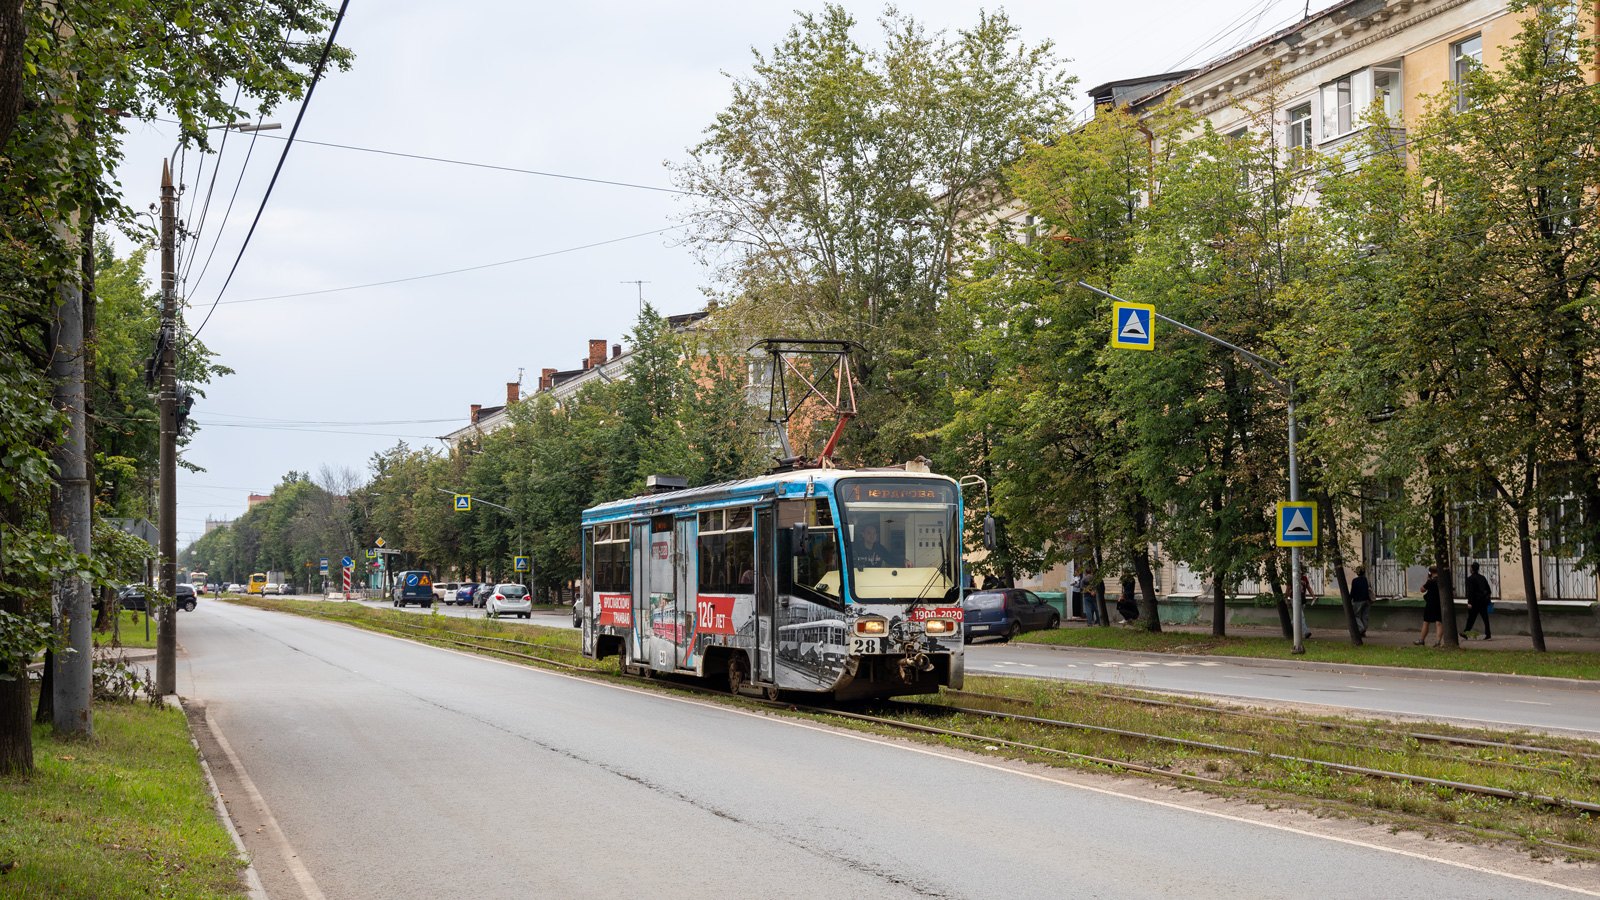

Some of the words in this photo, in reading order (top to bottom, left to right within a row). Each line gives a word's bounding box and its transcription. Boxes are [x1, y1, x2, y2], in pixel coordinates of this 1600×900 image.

[853, 485, 860, 500] 1
[698, 601, 713, 628] 120
[715, 614, 725, 629] ЛЕТ
[914, 610, 963, 620] 1900-2020
[854, 639, 876, 653] 28
